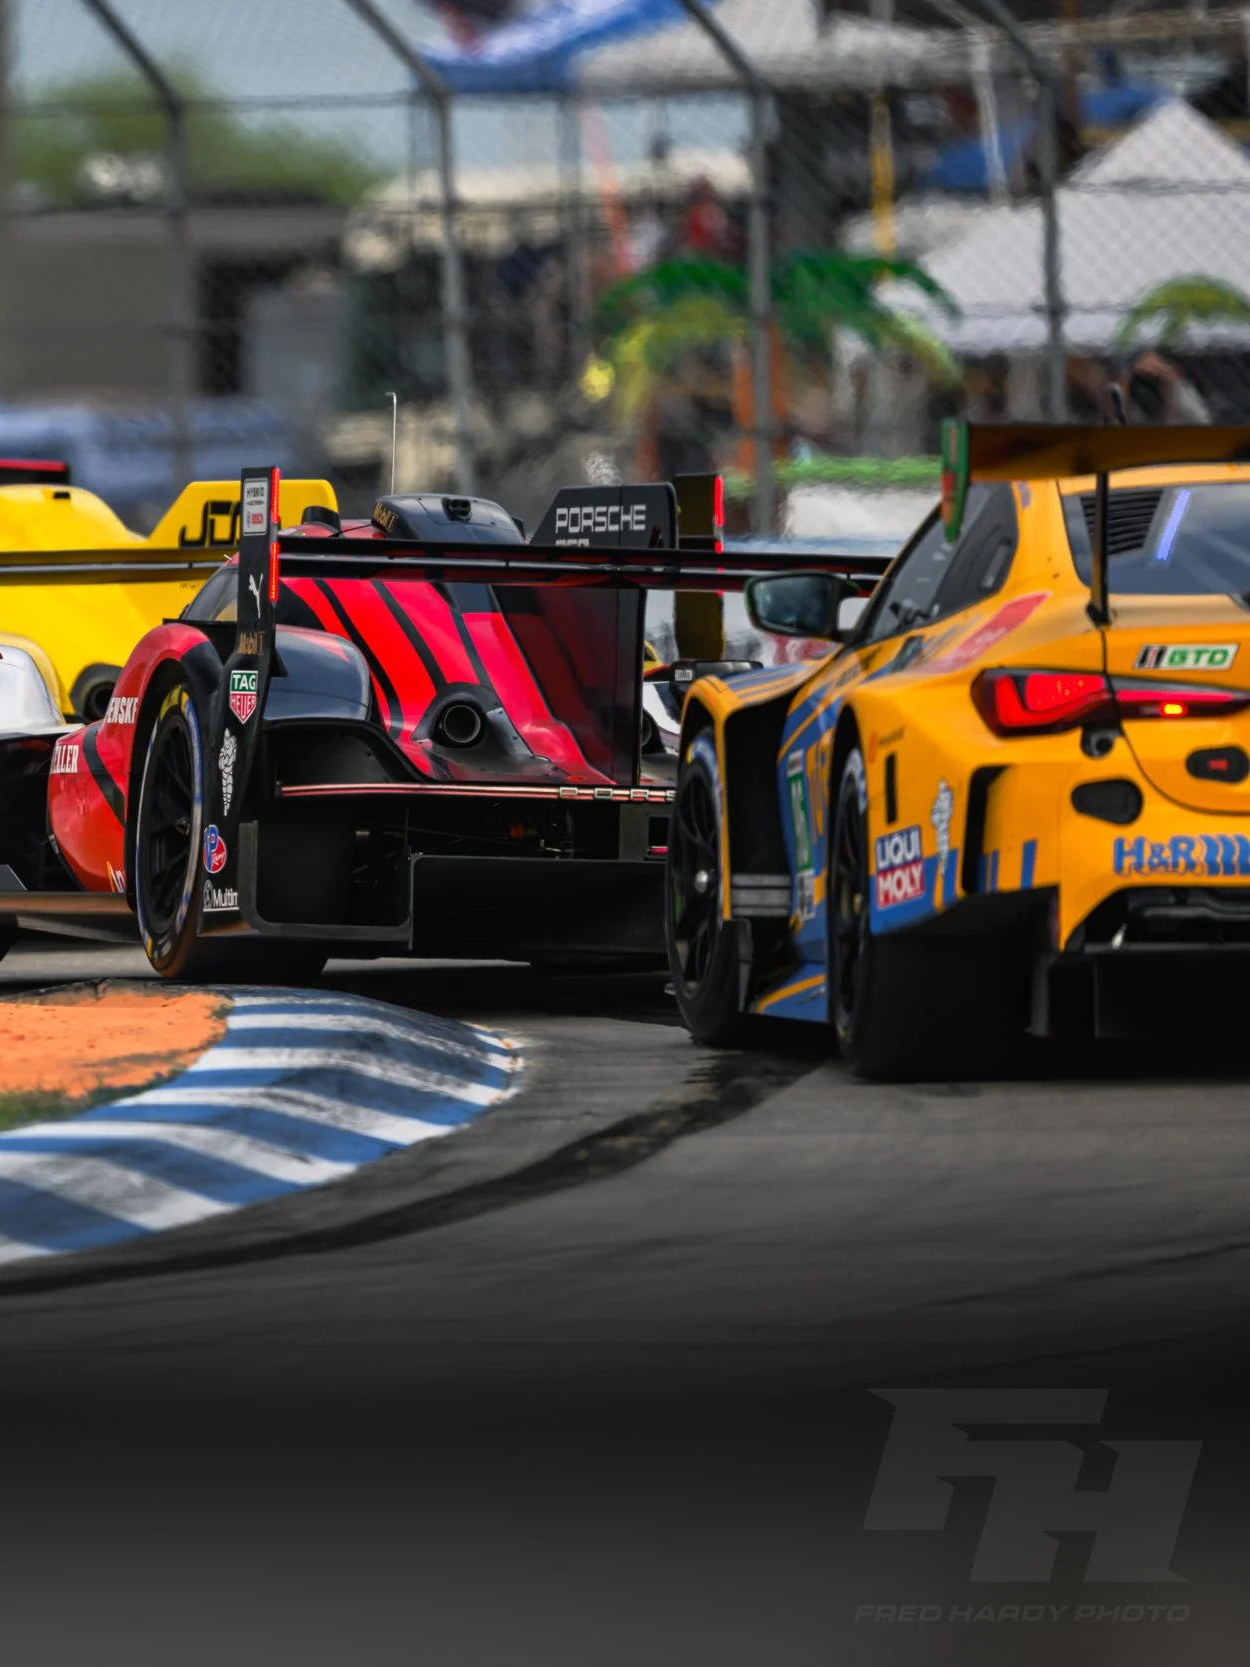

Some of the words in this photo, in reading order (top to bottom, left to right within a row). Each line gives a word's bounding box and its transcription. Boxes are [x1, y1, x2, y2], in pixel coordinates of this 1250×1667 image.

[555, 504, 647, 533] PORSCHE
[1167, 648, 1230, 667] GTD
[232, 674, 256, 690] TAG
[230, 695, 256, 719] HEUER
[877, 829, 921, 868] LIQUI
[1113, 835, 1195, 875] H&R
[877, 862, 924, 906] MOLY
